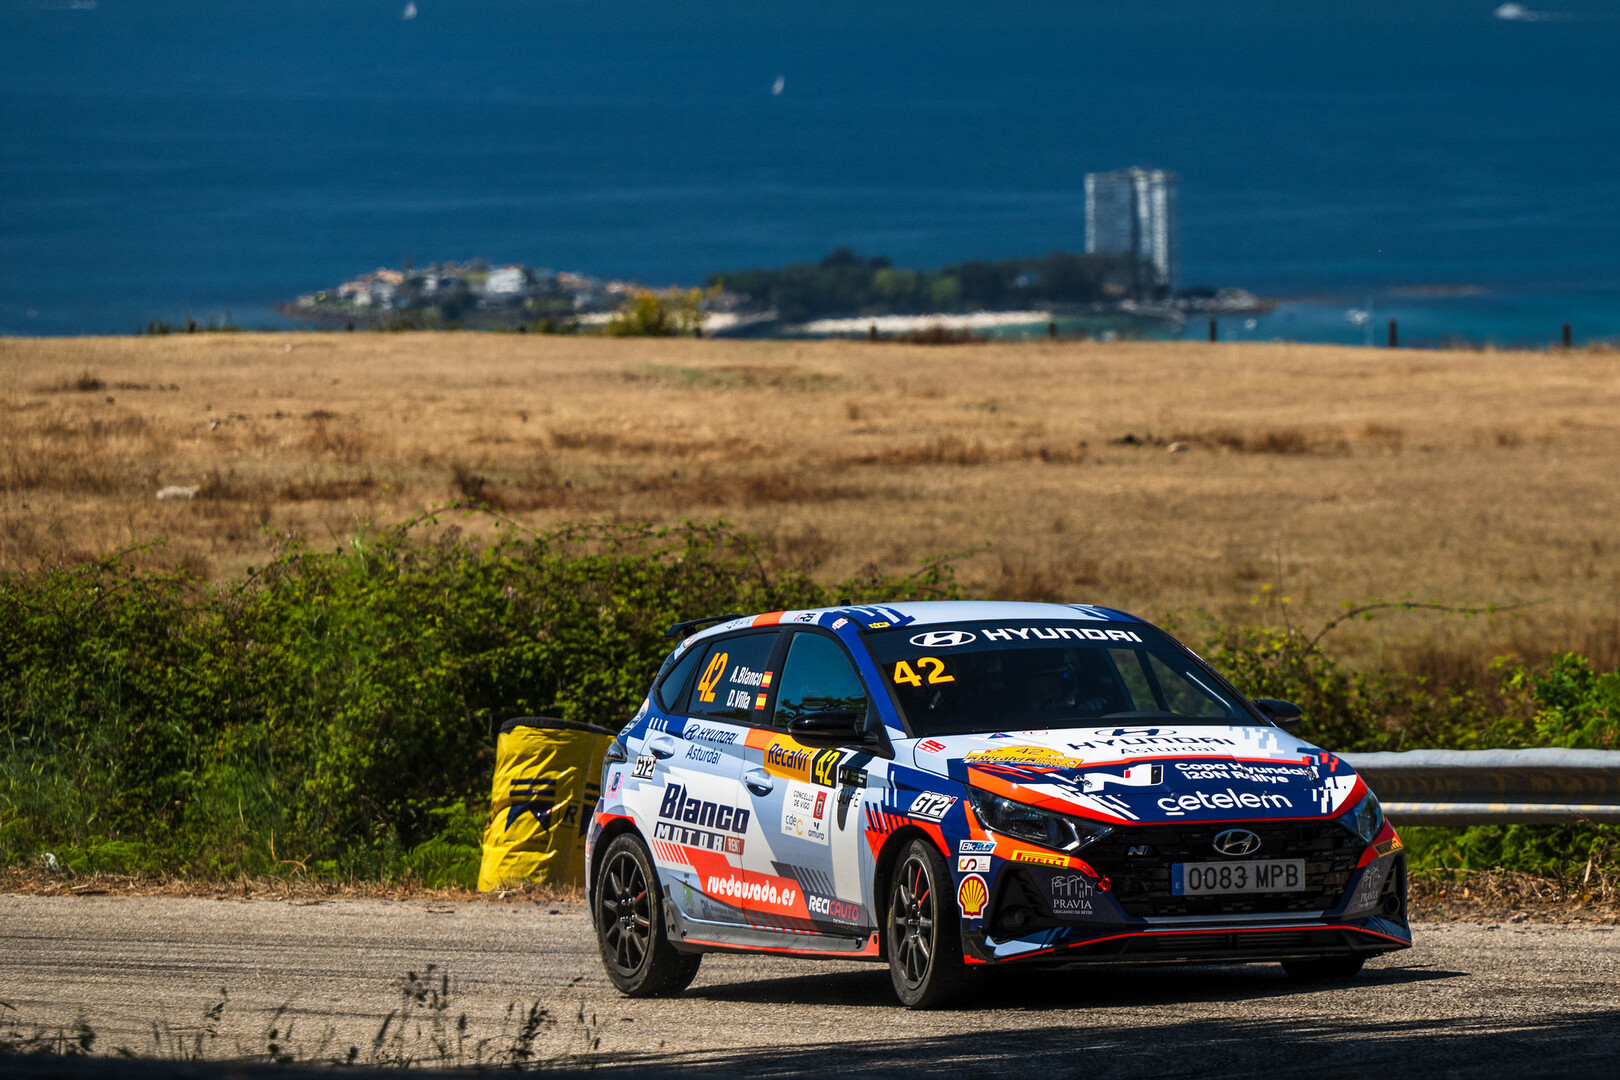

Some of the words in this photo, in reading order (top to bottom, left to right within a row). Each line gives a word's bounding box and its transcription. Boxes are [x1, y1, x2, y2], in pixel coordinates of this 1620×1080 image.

[981, 627, 1143, 643] HYUNDAI
[697, 652, 728, 703] 42
[729, 665, 763, 687] A.Blanco
[893, 656, 956, 687] 42
[726, 689, 751, 709] D.Villa
[697, 727, 739, 745] HYUNDAI
[1067, 736, 1236, 750] HYUNDAI
[684, 744, 722, 765] Asturdai
[767, 743, 812, 771] Recalvi
[1120, 745, 1216, 755] Asturdai
[815, 749, 840, 786] 42
[1174, 762, 1226, 773] Copa
[1184, 770, 1230, 780] i20N
[1236, 770, 1290, 784] Rallye
[793, 790, 815, 802] CONCELLO
[1157, 788, 1293, 813] cetelem
[658, 782, 751, 835] Blanco
[655, 822, 725, 852] MOTOR
[1015, 852, 1066, 867] PIRELLI
[1188, 866, 1247, 890] 0083
[1256, 864, 1298, 888] MPB
[707, 874, 796, 907] ruedausada.es
[1053, 899, 1092, 910] PRAVIA
